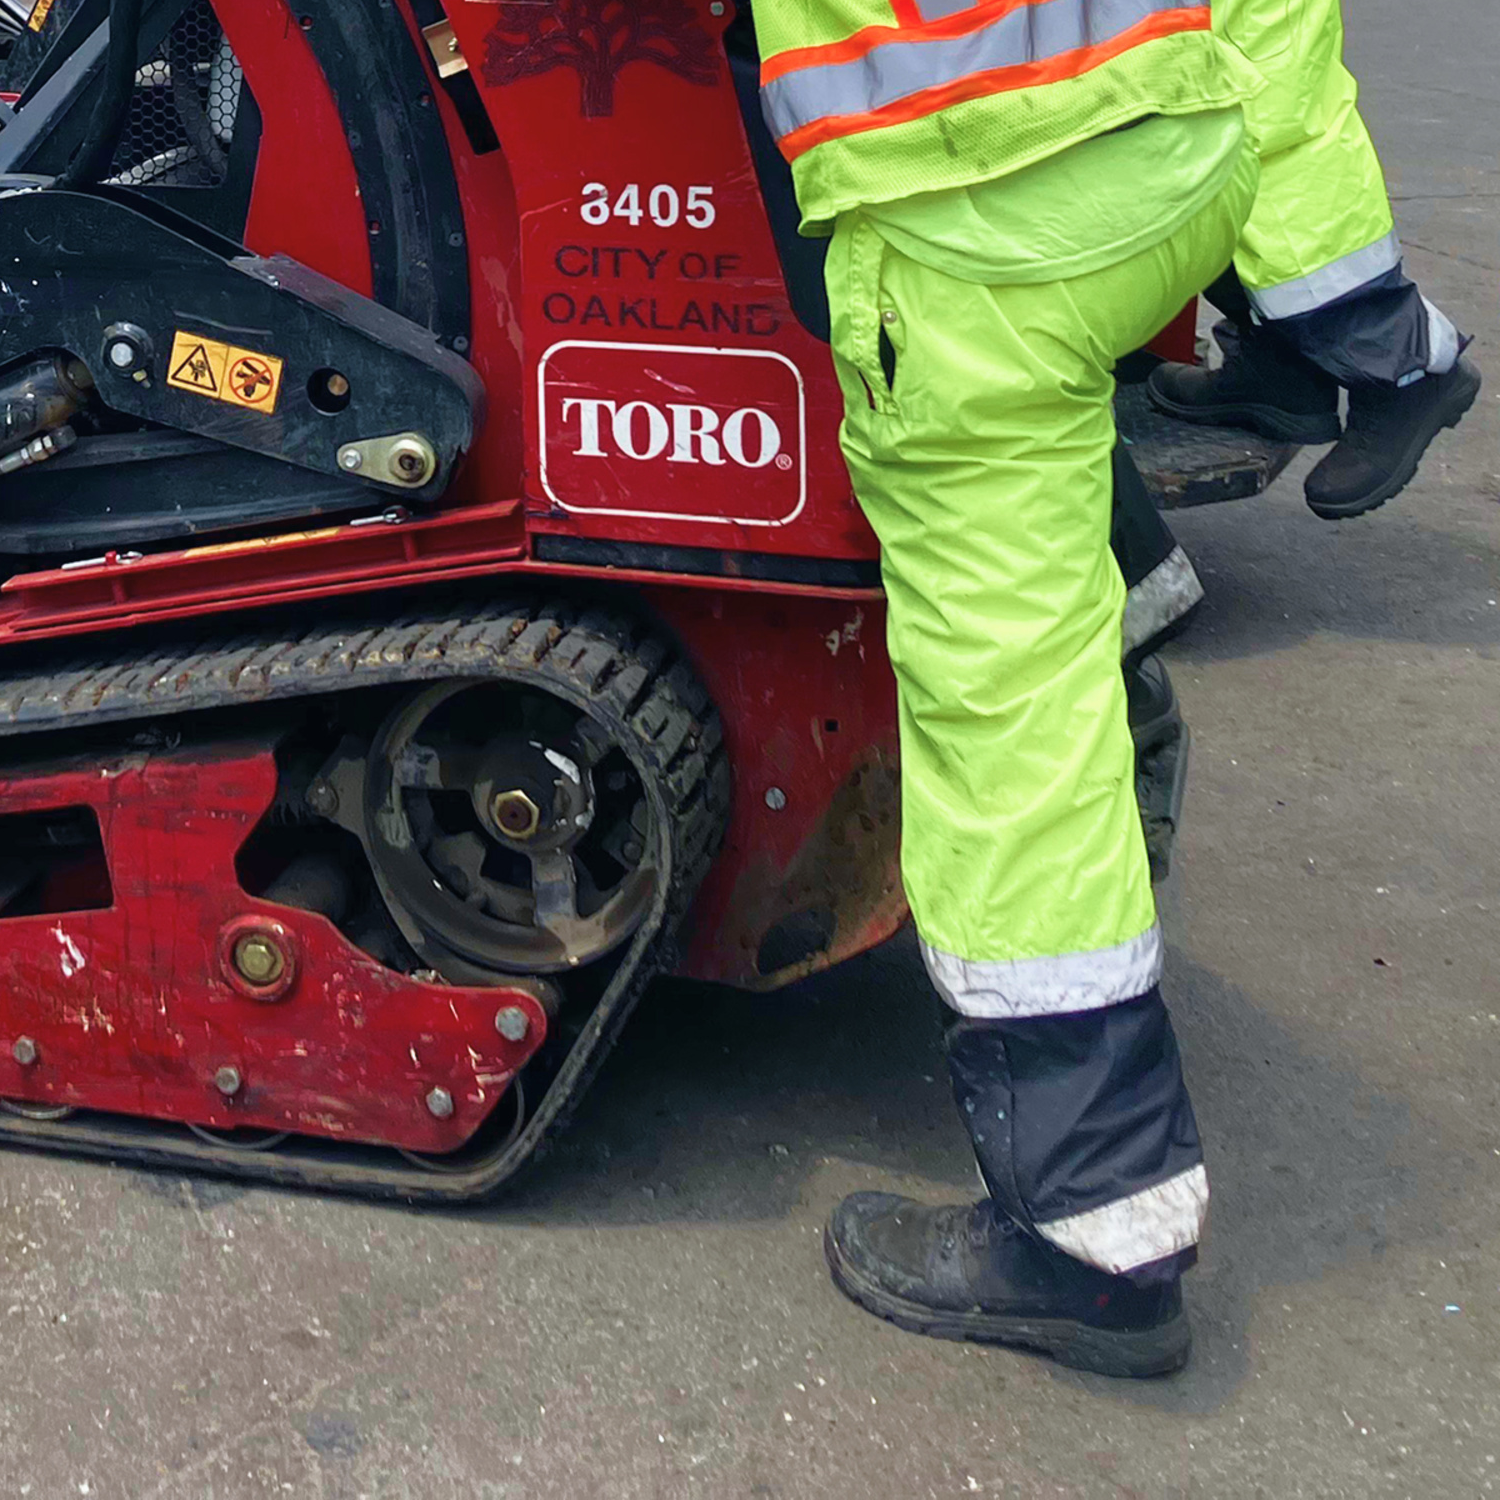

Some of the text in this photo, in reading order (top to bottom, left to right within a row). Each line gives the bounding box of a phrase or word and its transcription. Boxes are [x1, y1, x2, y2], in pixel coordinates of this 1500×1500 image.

[580, 182, 716, 229] 3405
[555, 245, 742, 280] CITY OF
[543, 292, 780, 337] OAKLAND
[562, 397, 781, 469] TORO
